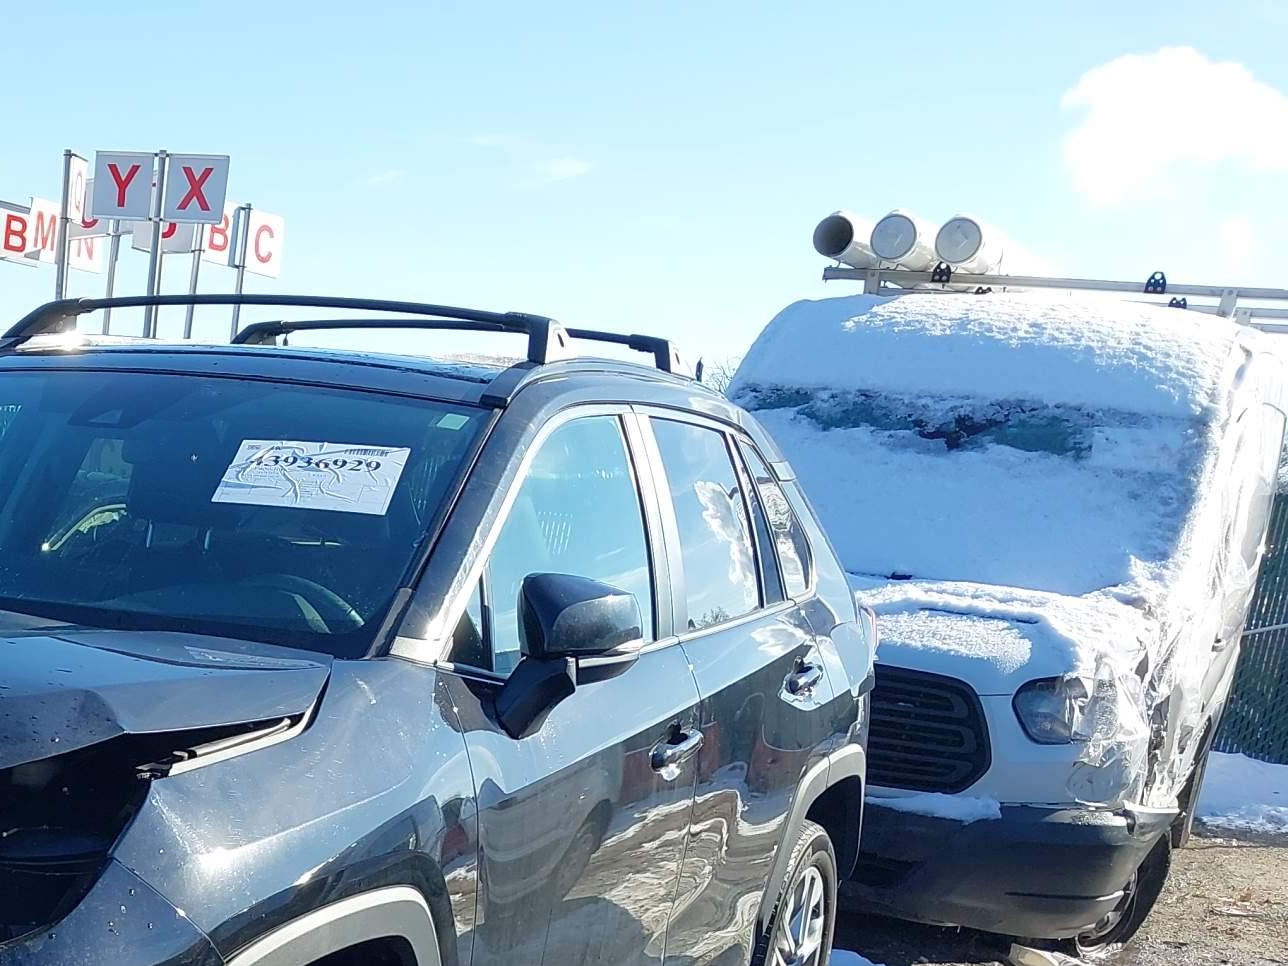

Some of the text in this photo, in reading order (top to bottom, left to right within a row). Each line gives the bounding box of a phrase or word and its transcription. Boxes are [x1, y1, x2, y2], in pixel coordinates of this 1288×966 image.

[107, 163, 141, 207] Y
[176, 165, 214, 211] X
[3, 214, 28, 253] B
[34, 210, 57, 252] M
[255, 224, 275, 263] C
